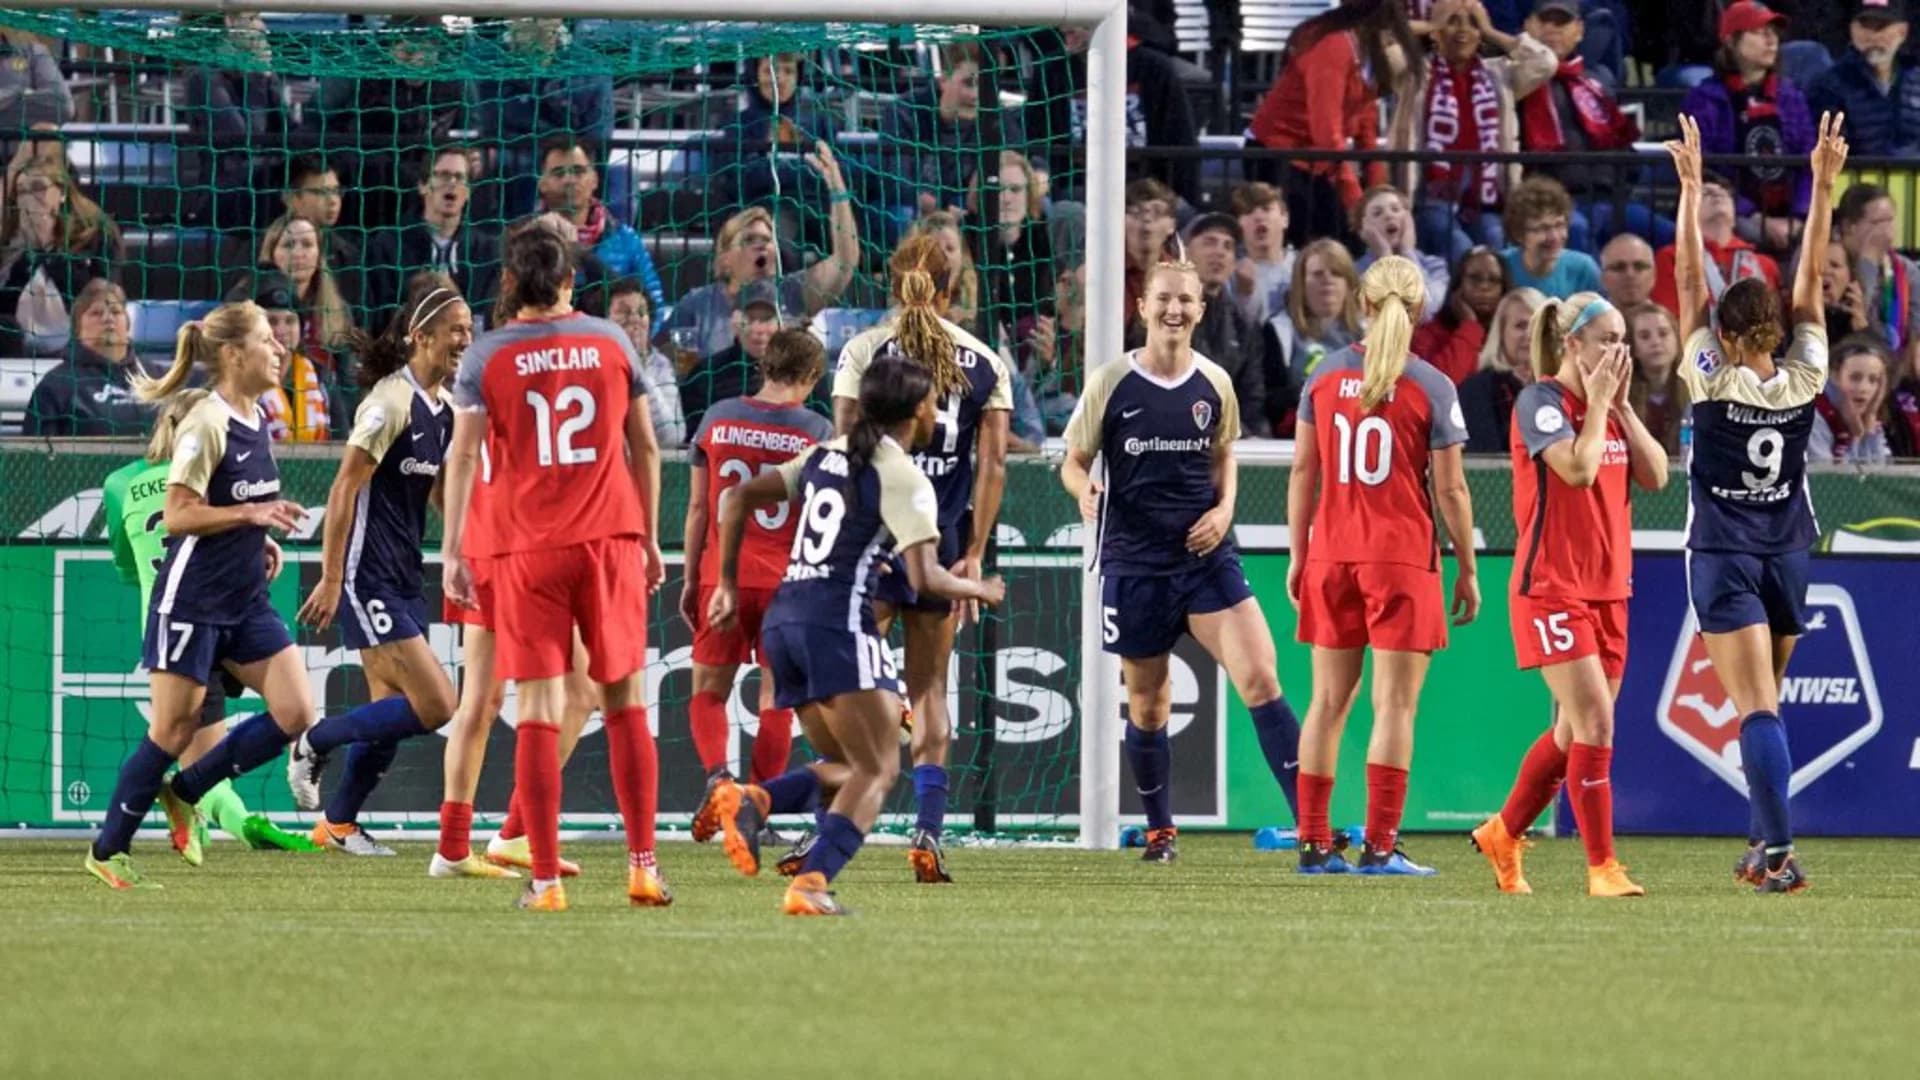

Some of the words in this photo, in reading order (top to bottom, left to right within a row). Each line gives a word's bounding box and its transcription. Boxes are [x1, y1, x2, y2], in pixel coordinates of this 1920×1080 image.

[514, 346, 601, 376] SINCLAIR
[526, 384, 598, 466] 12
[711, 425, 809, 454] KLINGENBERG
[1124, 437, 1203, 456] Continental
[1334, 412, 1393, 486] 10
[1741, 427, 1785, 493] 9
[790, 480, 846, 565] 19
[367, 599, 393, 635] 6
[1103, 607, 1120, 645] 5
[1533, 611, 1575, 656] 15
[169, 622, 194, 663] 7
[1778, 677, 1860, 704] NWSL
